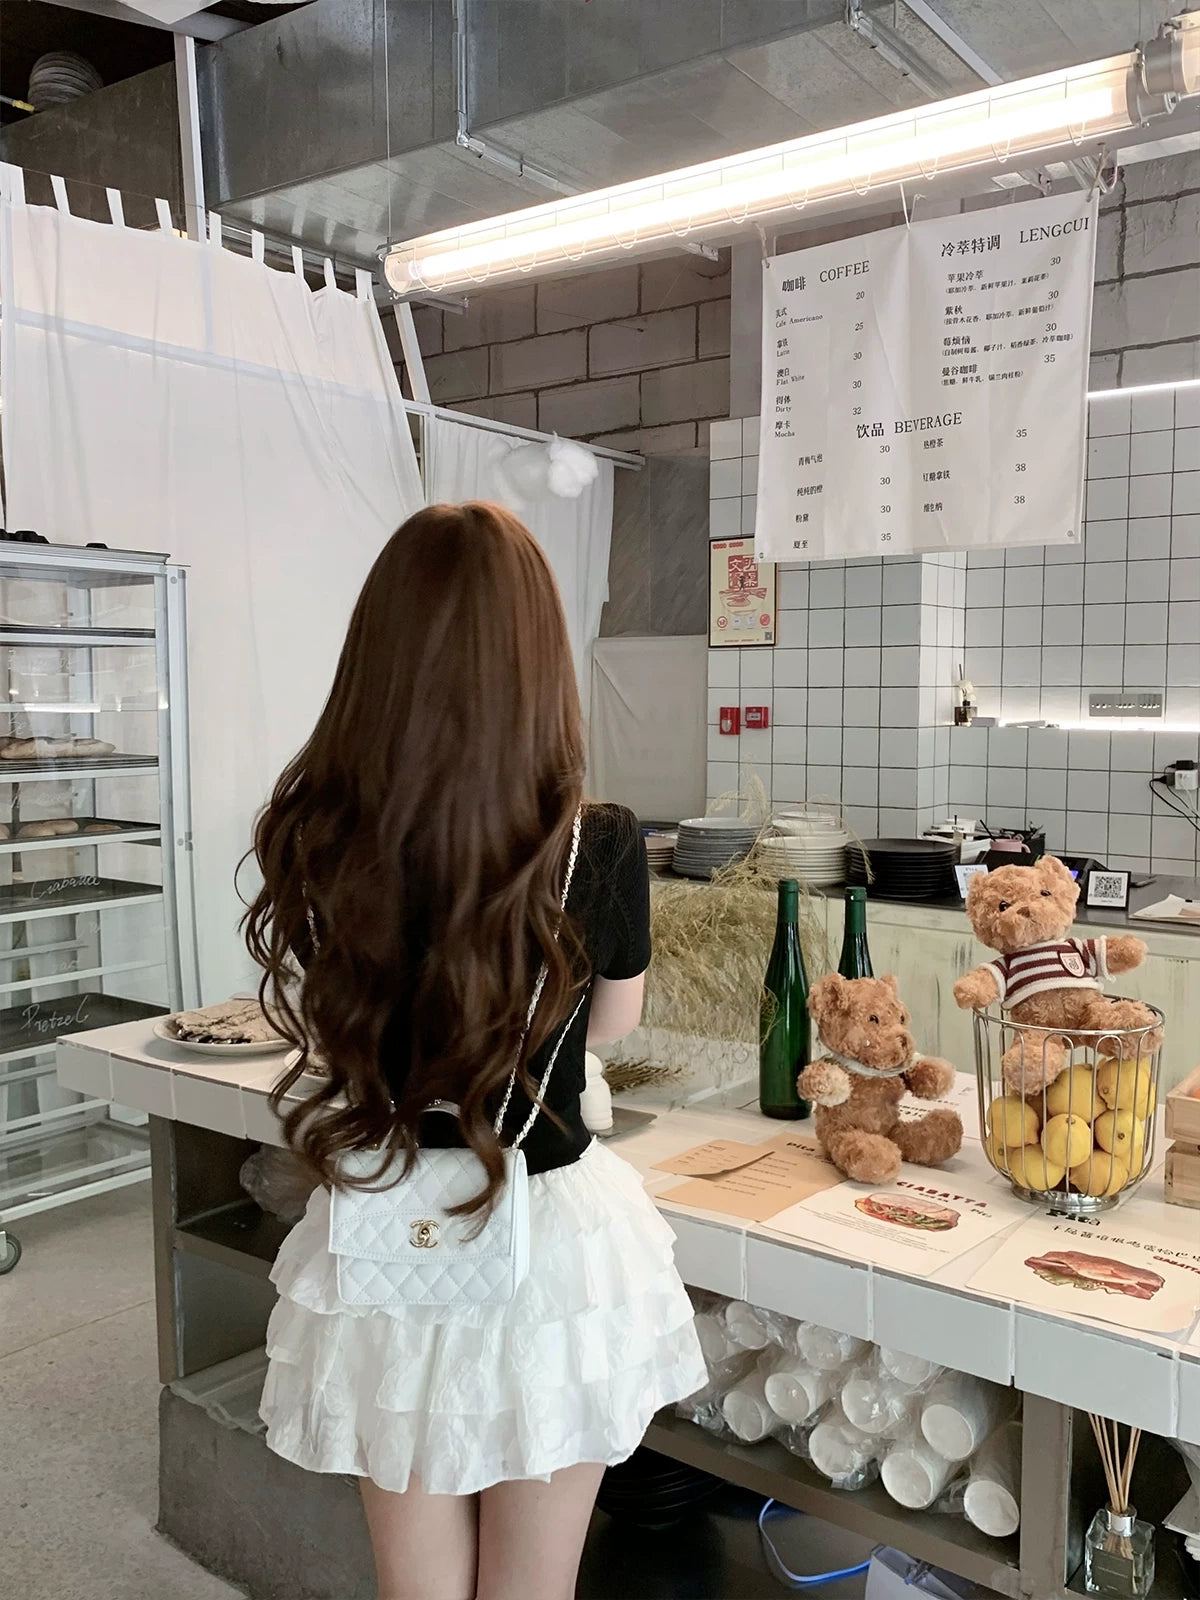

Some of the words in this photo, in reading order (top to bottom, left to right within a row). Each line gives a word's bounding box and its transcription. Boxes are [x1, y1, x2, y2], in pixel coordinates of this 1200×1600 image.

[941, 234, 1001, 258] 冷萃特调
[1019, 216, 1090, 245] LENGCUI
[1050, 255, 1062, 267] 30
[782, 275, 807, 293] 咖啡
[819, 260, 871, 283] COFFEE
[946, 269, 985, 284] 苹果冷萃
[855, 291, 866, 301] 20
[1048, 290, 1059, 301] 30
[944, 304, 963, 317] 紫秋
[789, 314, 824, 326] Americano
[855, 323, 864, 331] 25
[1045, 322, 1057, 333] 30
[776, 349, 791, 358] Latte
[853, 352, 862, 361] 30
[1044, 354, 1056, 364] 35
[776, 368, 790, 378] 澳白
[941, 363, 978, 377] 曼谷咖啡
[776, 378, 789, 386] Flat
[791, 375, 805, 383] White
[852, 380, 862, 389] 30
[776, 395, 791, 405] 得体
[775, 405, 792, 413] Dirty
[852, 406, 862, 416] 32
[775, 420, 791, 430] 摩卡
[856, 423, 885, 439] 饮品
[894, 411, 963, 434] BEVERAGE
[775, 430, 796, 438] Mocha
[1016, 428, 1028, 438] 35
[879, 444, 891, 454] 30
[1015, 463, 1026, 473] 38
[880, 476, 891, 486] 30
[1014, 495, 1025, 505] 38
[880, 504, 891, 514] 30
[881, 532, 892, 542] 35
[896, 1181, 988, 1208] CIABATTA
